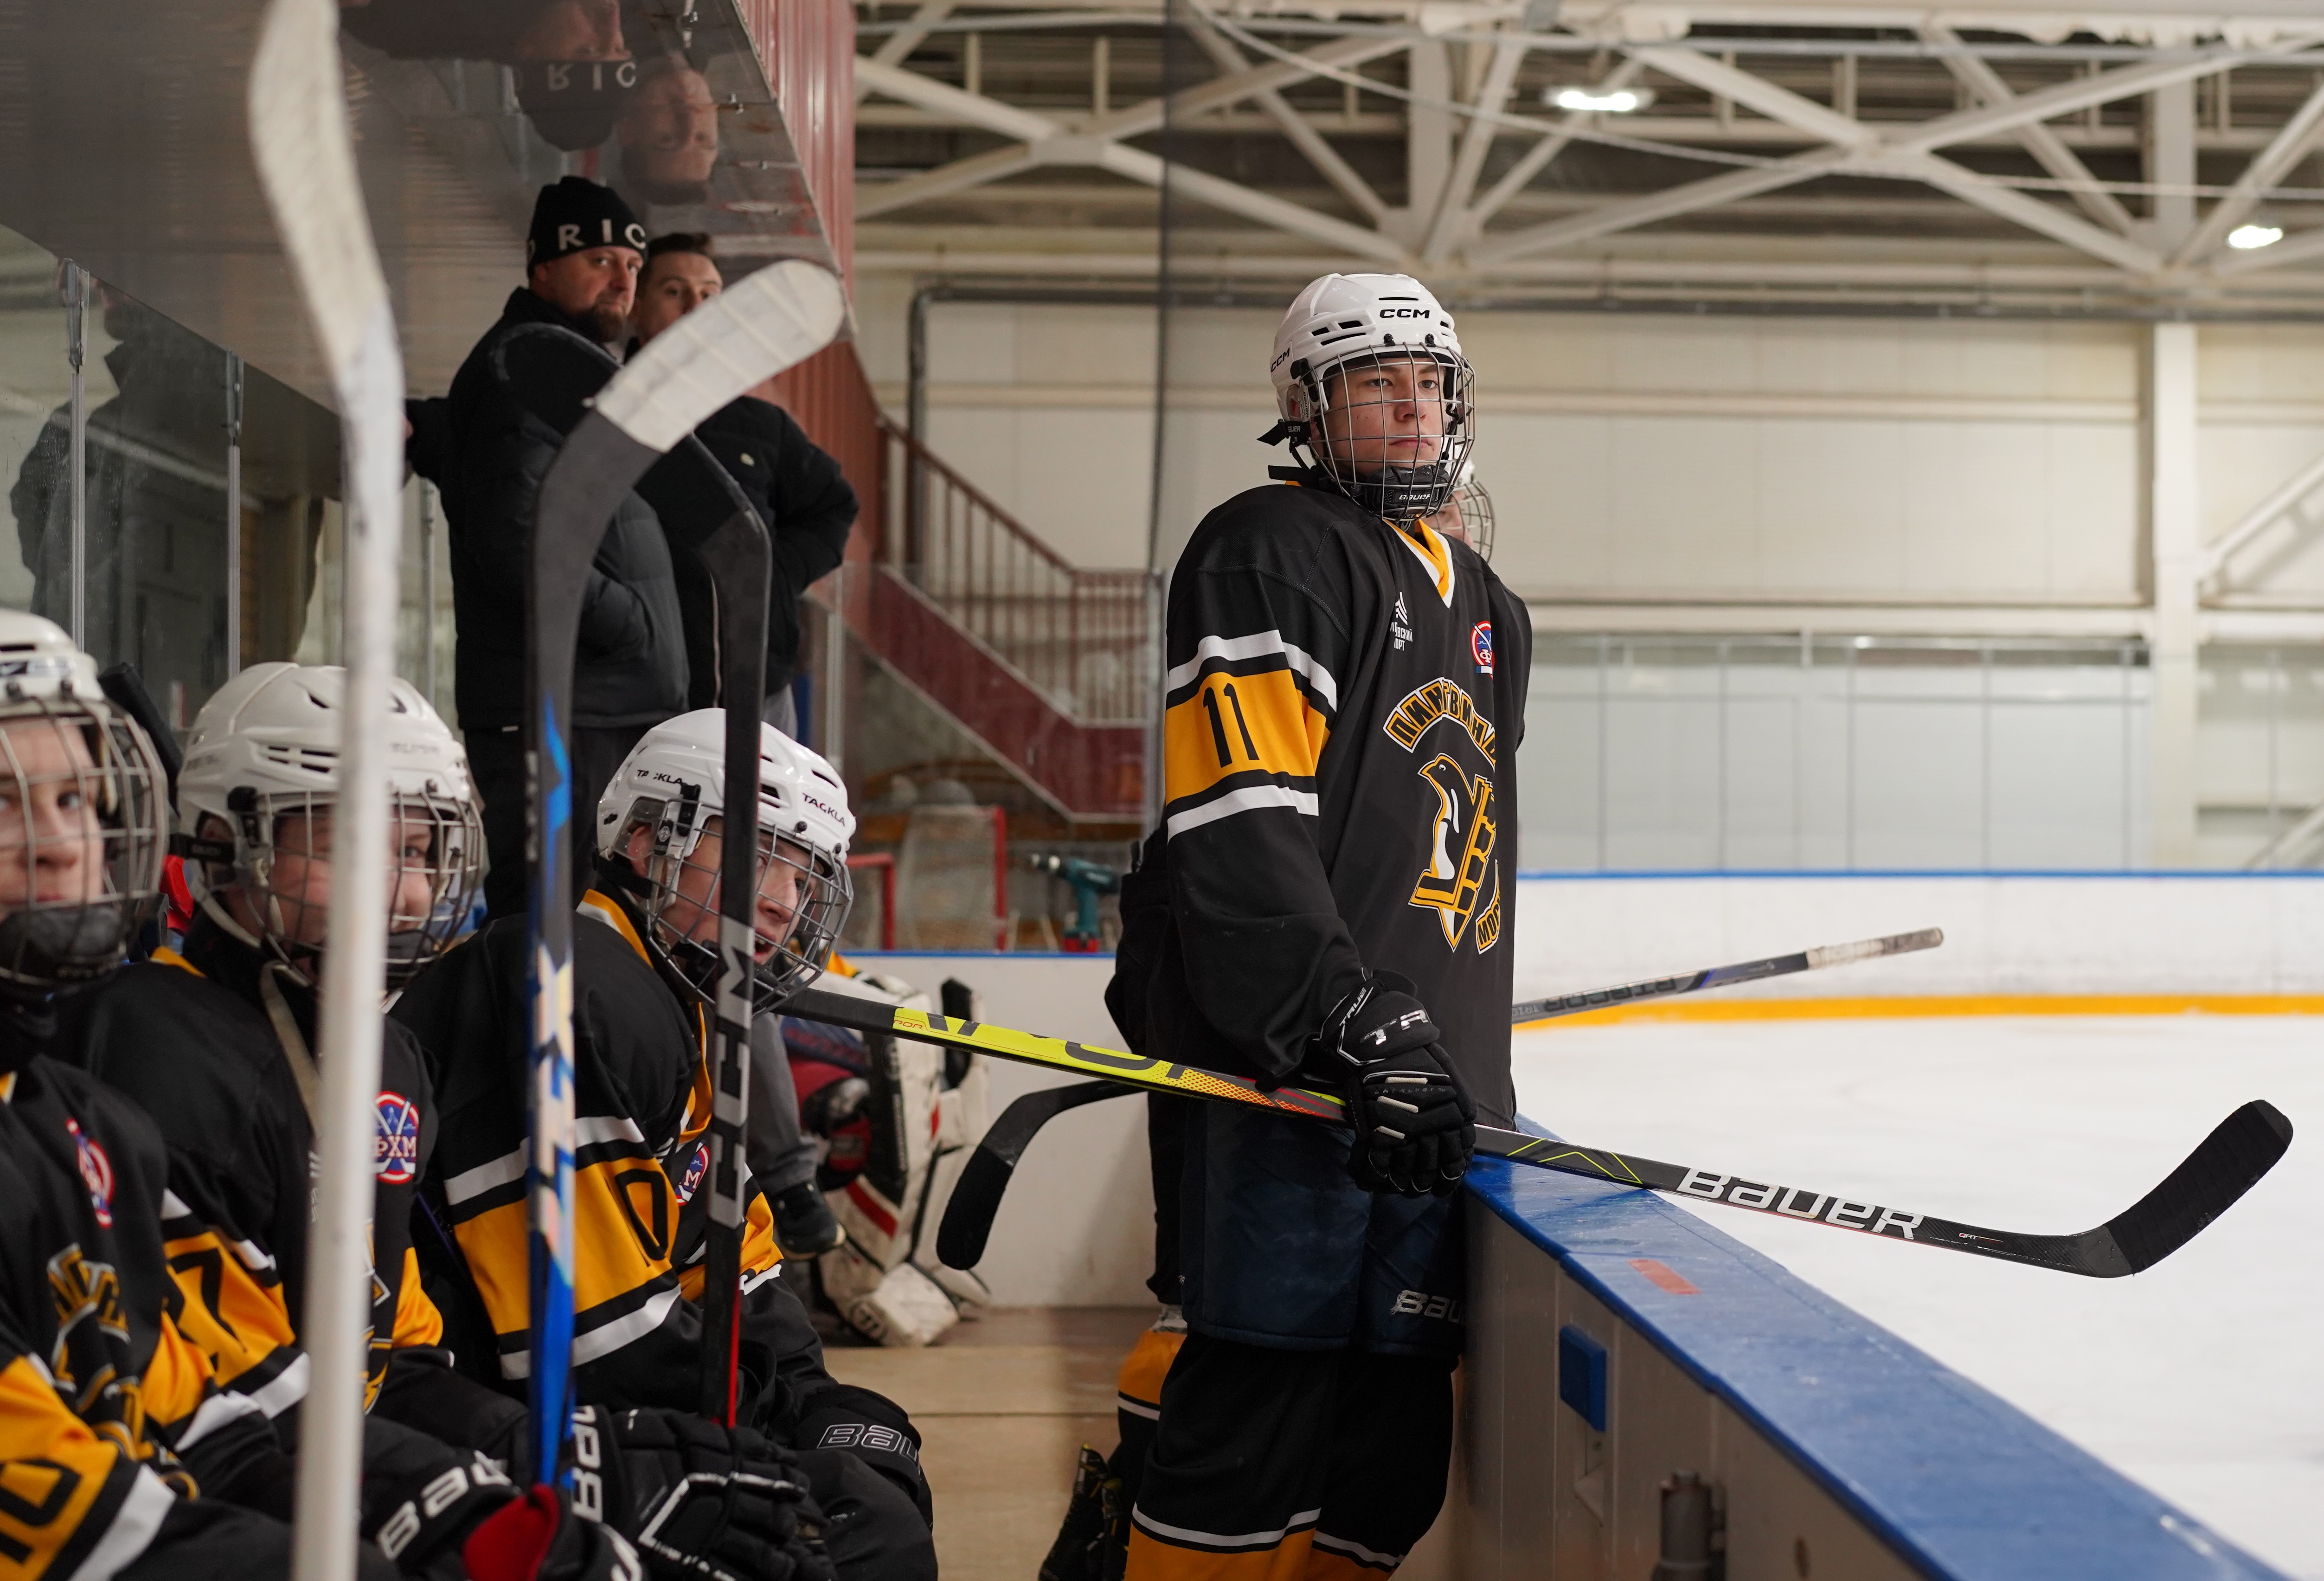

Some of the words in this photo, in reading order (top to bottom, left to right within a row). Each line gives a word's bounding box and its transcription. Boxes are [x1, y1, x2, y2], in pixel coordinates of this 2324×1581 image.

[1379, 309, 1430, 319] CCM
[1271, 347, 1290, 373] CCM
[1203, 682, 1260, 768] 11
[637, 769, 683, 785] TAKLA
[802, 792, 846, 827] TACKLA
[893, 1020, 923, 1030] POR
[708, 914, 755, 1229] CCM
